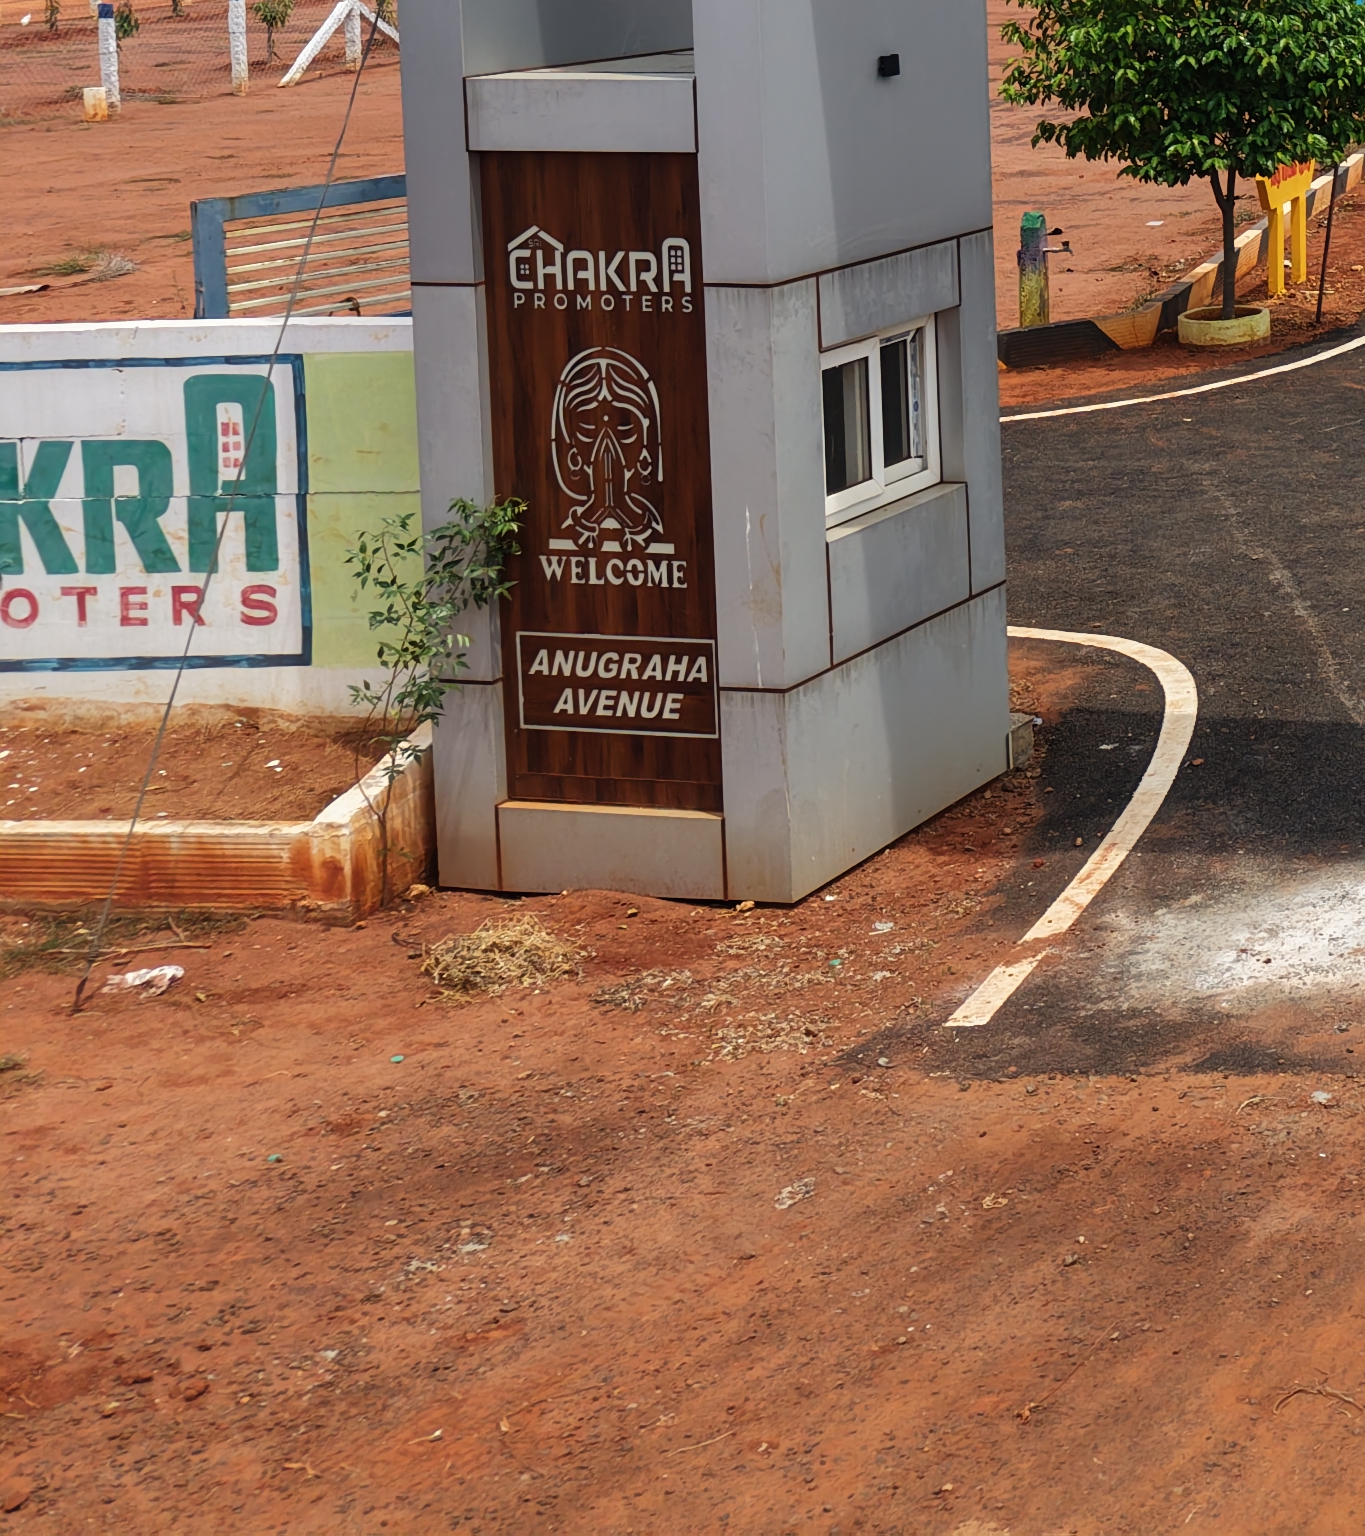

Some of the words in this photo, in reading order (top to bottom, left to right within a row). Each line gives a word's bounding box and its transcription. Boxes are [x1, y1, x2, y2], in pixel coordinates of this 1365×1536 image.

[509, 237, 692, 293] CHAKRA
[513, 292, 693, 313] PROMOTERS
[539, 555, 688, 588] WELCOME
[528, 649, 708, 683] ANUGRAHA
[553, 688, 684, 720] AVENUE
